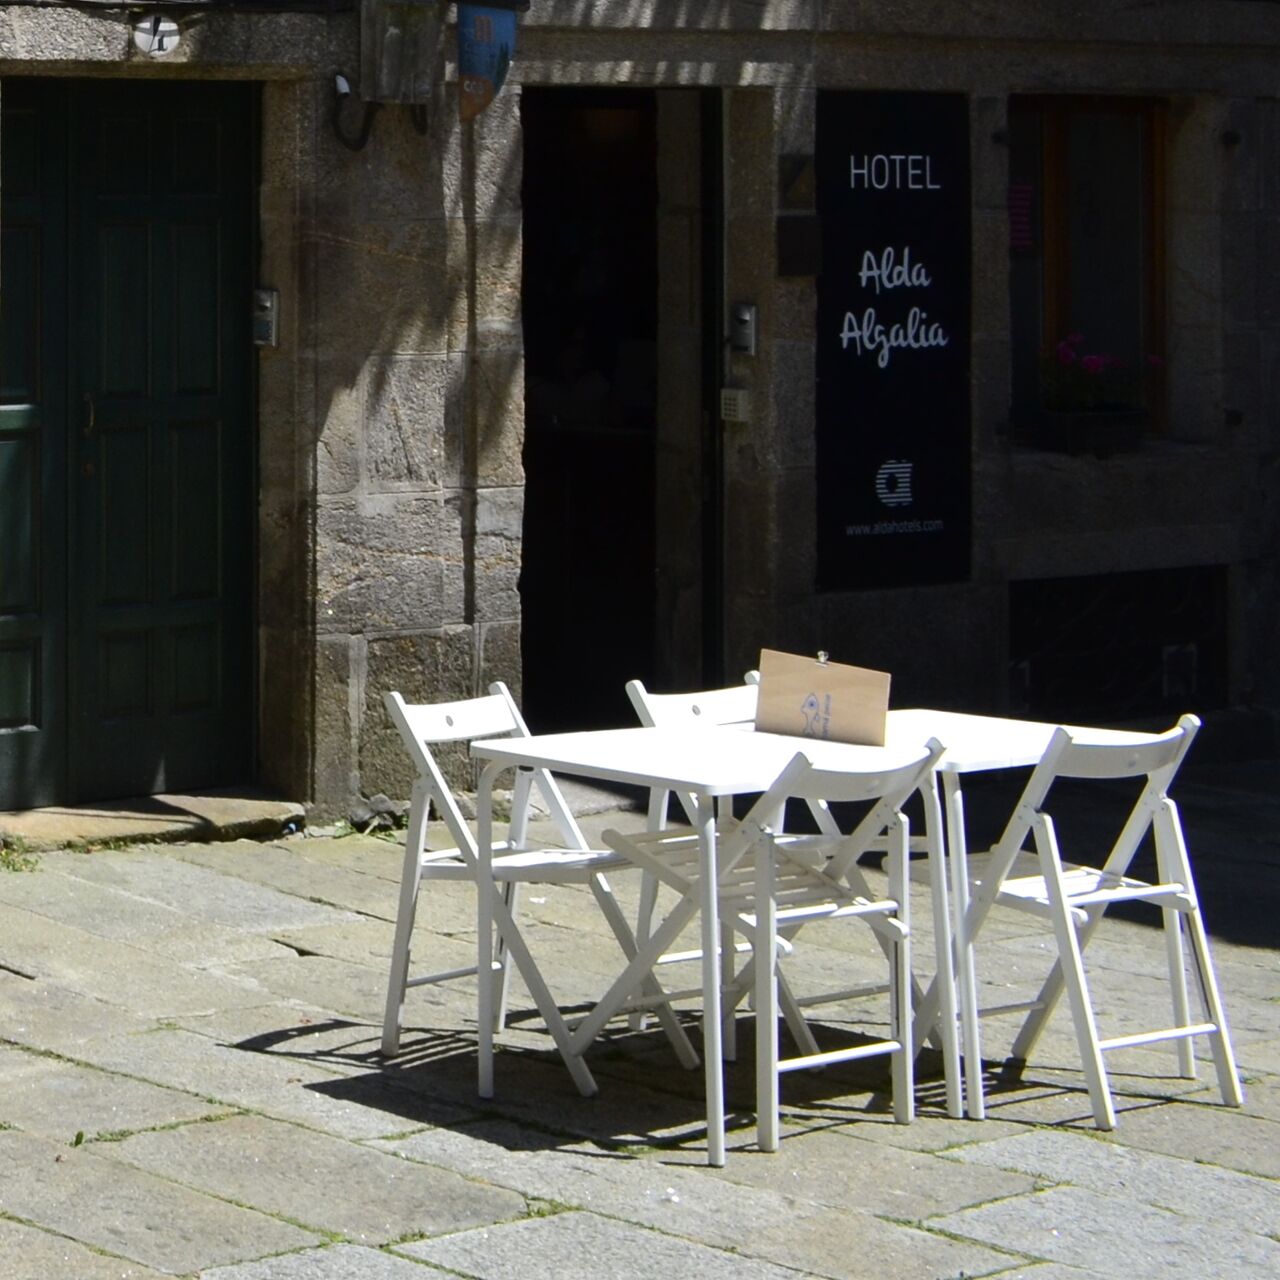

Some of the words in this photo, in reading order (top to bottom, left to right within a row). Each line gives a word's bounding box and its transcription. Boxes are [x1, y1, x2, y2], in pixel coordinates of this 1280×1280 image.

[850, 153, 941, 190] HOTEL
[858, 245, 932, 295] Alda
[839, 306, 949, 369] Algalia
